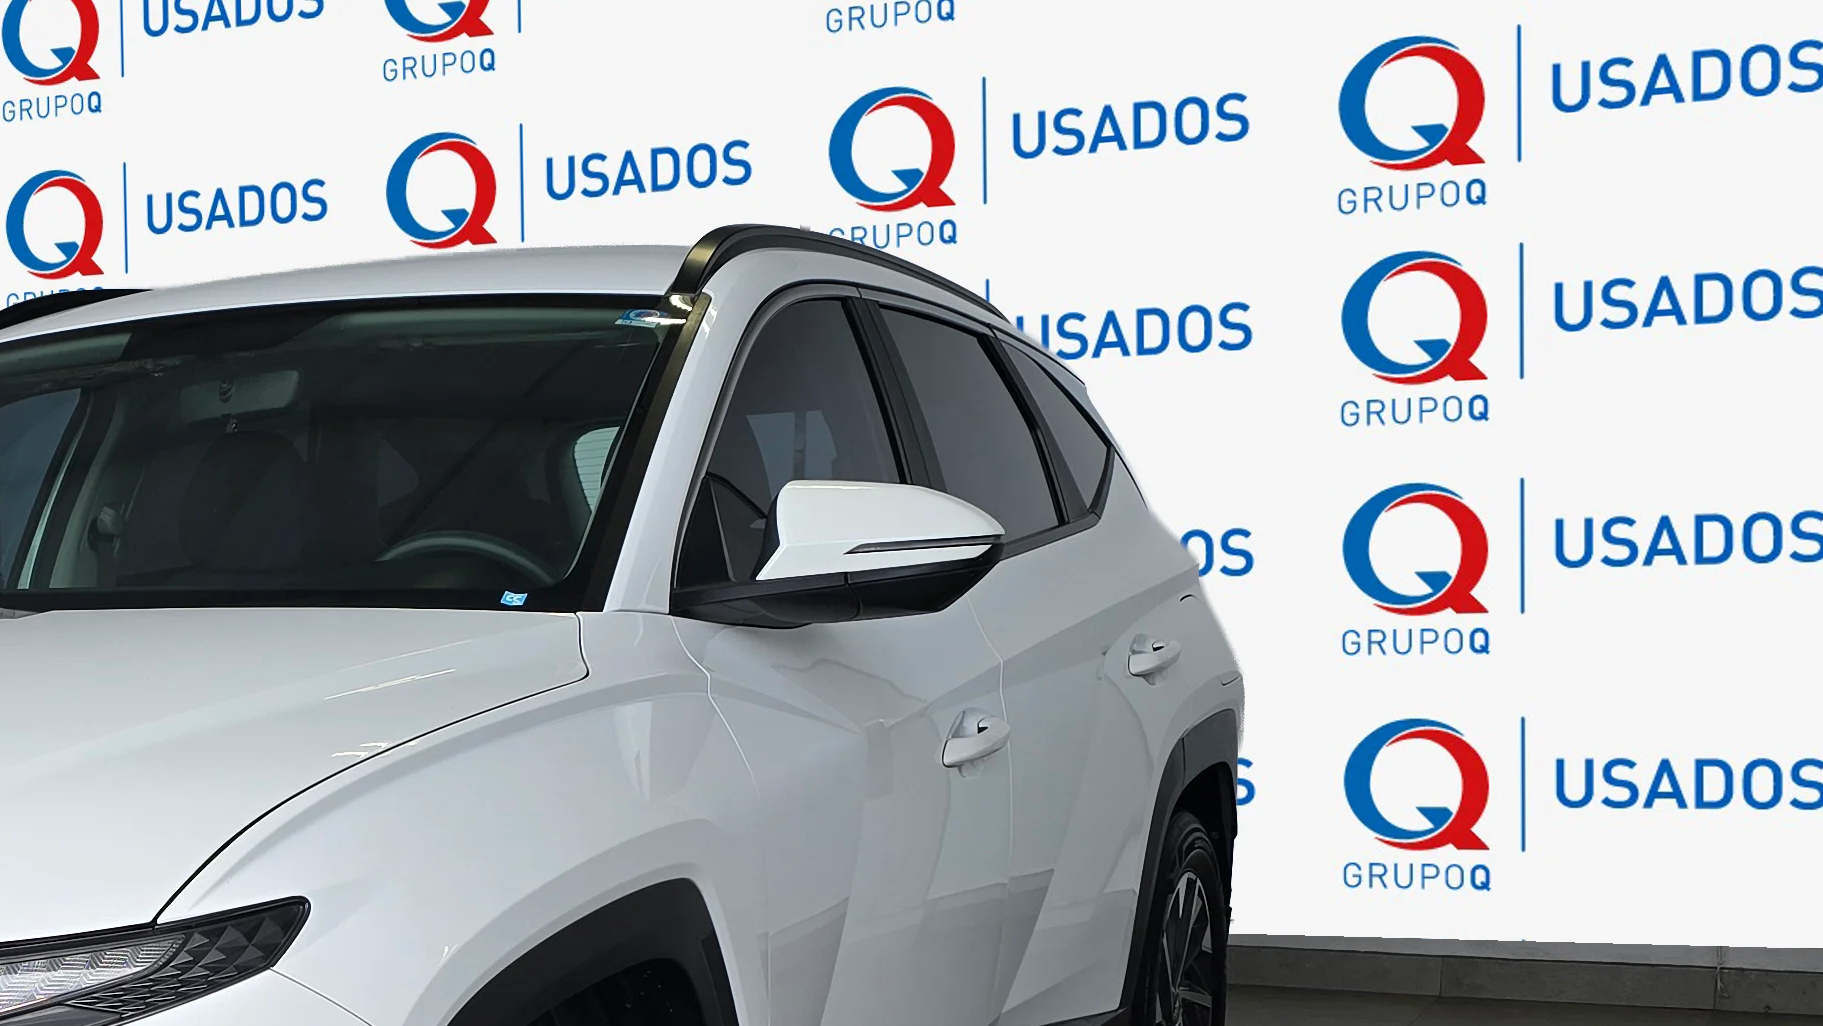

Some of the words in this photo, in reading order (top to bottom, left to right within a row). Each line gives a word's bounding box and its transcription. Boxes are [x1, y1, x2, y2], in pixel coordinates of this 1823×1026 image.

[382, 48, 496, 82] GRUPOQ
[1552, 39, 1823, 113] USADOS
[2, 91, 102, 122] GRUPOQ
[1012, 92, 1249, 159] USADOS
[546, 139, 752, 201] USADOS
[1337, 178, 1487, 214] GRUPOQ
[146, 179, 328, 235] USADOS
[1554, 265, 1823, 332] USADOS
[1341, 394, 1489, 426] GRUPOQ
[1554, 510, 1823, 568] USADOS
[1342, 627, 1490, 656] GRUPOQ
[1555, 757, 1823, 811] USADOS
[1343, 862, 1491, 892] GRUPOQ
